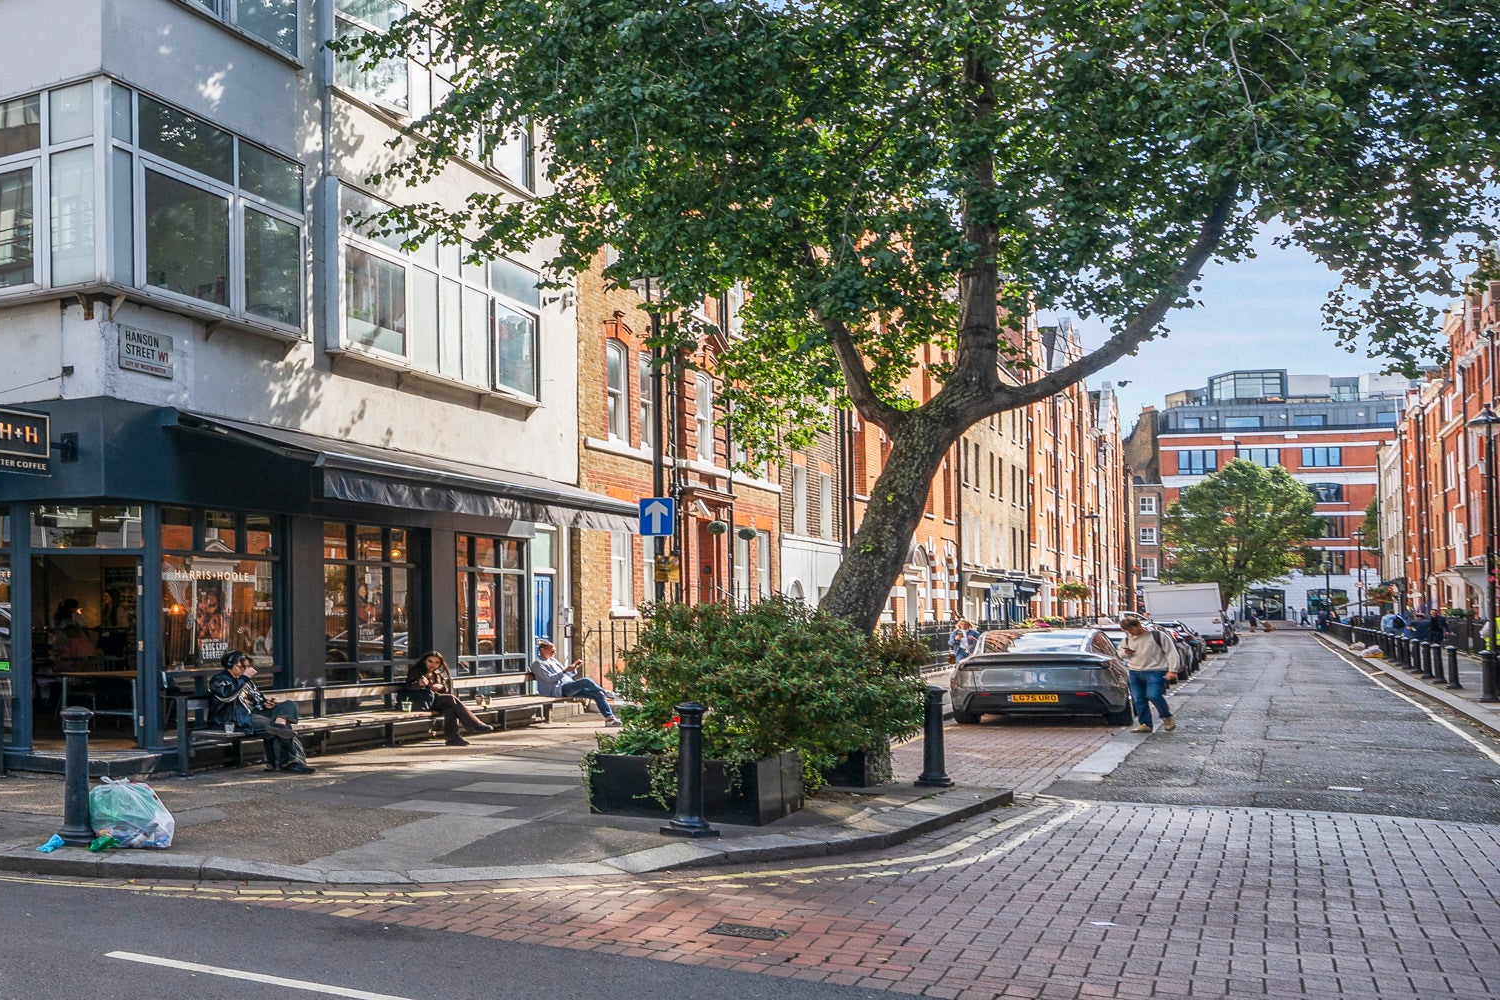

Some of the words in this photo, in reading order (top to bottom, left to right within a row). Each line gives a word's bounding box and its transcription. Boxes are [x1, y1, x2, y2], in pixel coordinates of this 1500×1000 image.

[125, 330, 159, 348] HANSON
[125, 343, 156, 360] STREET
[157, 351, 169, 364] W1
[16, 461, 47, 471] COFFEE
[174, 569, 250, 582] HARRIS+HOOLE
